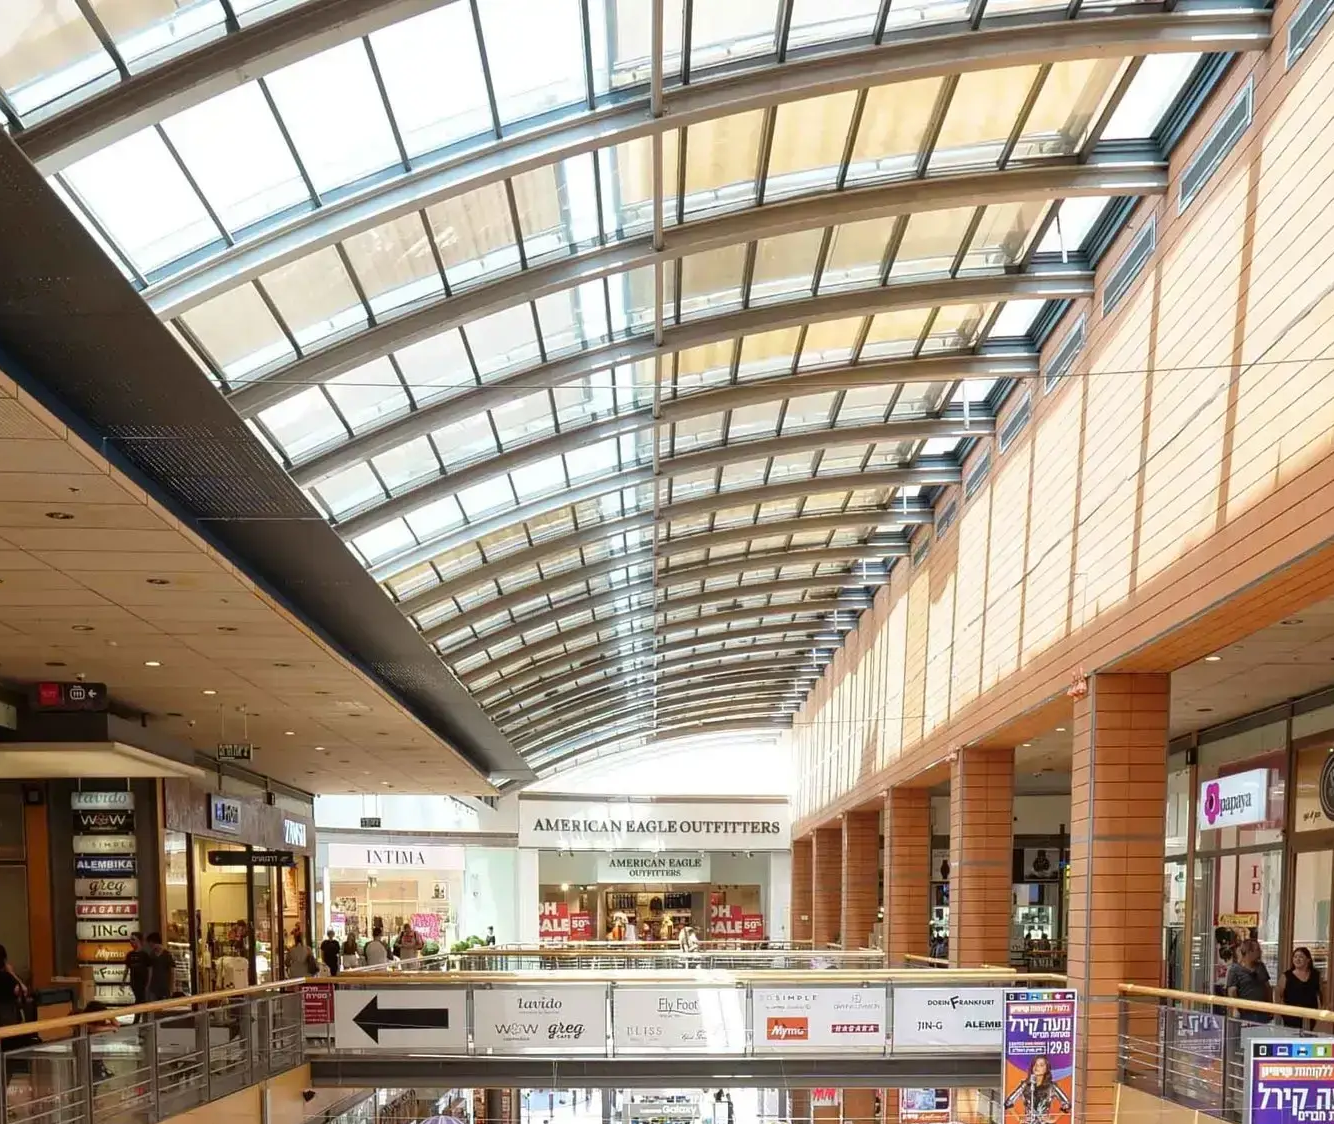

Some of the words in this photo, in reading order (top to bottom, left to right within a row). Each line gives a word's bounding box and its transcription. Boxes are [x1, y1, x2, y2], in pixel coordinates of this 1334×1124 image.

[1219, 791, 1252, 817] papaya
[533, 818, 622, 834] AMERICAN
[626, 820, 677, 834] EAGLE
[679, 820, 781, 834] OUTFITTERS
[366, 849, 426, 865] INTIMA
[609, 857, 666, 868] AMERICAN
[668, 857, 702, 868] EAGLE
[76, 860, 134, 869] ALEMBIKA
[629, 869, 681, 877] OUTFITTERS
[89, 879, 127, 896] greg
[81, 905, 131, 914] HAGARA
[92, 925, 128, 938] JIN-G
[517, 996, 562, 1009] lavido
[658, 998, 674, 1013] Fly
[676, 998, 698, 1010] Foot
[950, 996, 995, 1010] FRANKFURT
[547, 1021, 585, 1039] greg
[835, 1024, 876, 1032] HAGARA
[917, 1021, 943, 1031] JIN-G
[964, 1020, 1002, 1028] ALEMB
[1009, 1016, 1039, 1036] קירל
[1043, 1018, 1071, 1032] נועה
[627, 1026, 663, 1036] BLISS
[1050, 1041, 1070, 1054] 29.8
[1294, 1064, 1334, 1079] ללקוחות
[1257, 1082, 1309, 1116] קירל
[662, 1106, 697, 1117] Galaxy
[1297, 1110, 1327, 1122] חברים
